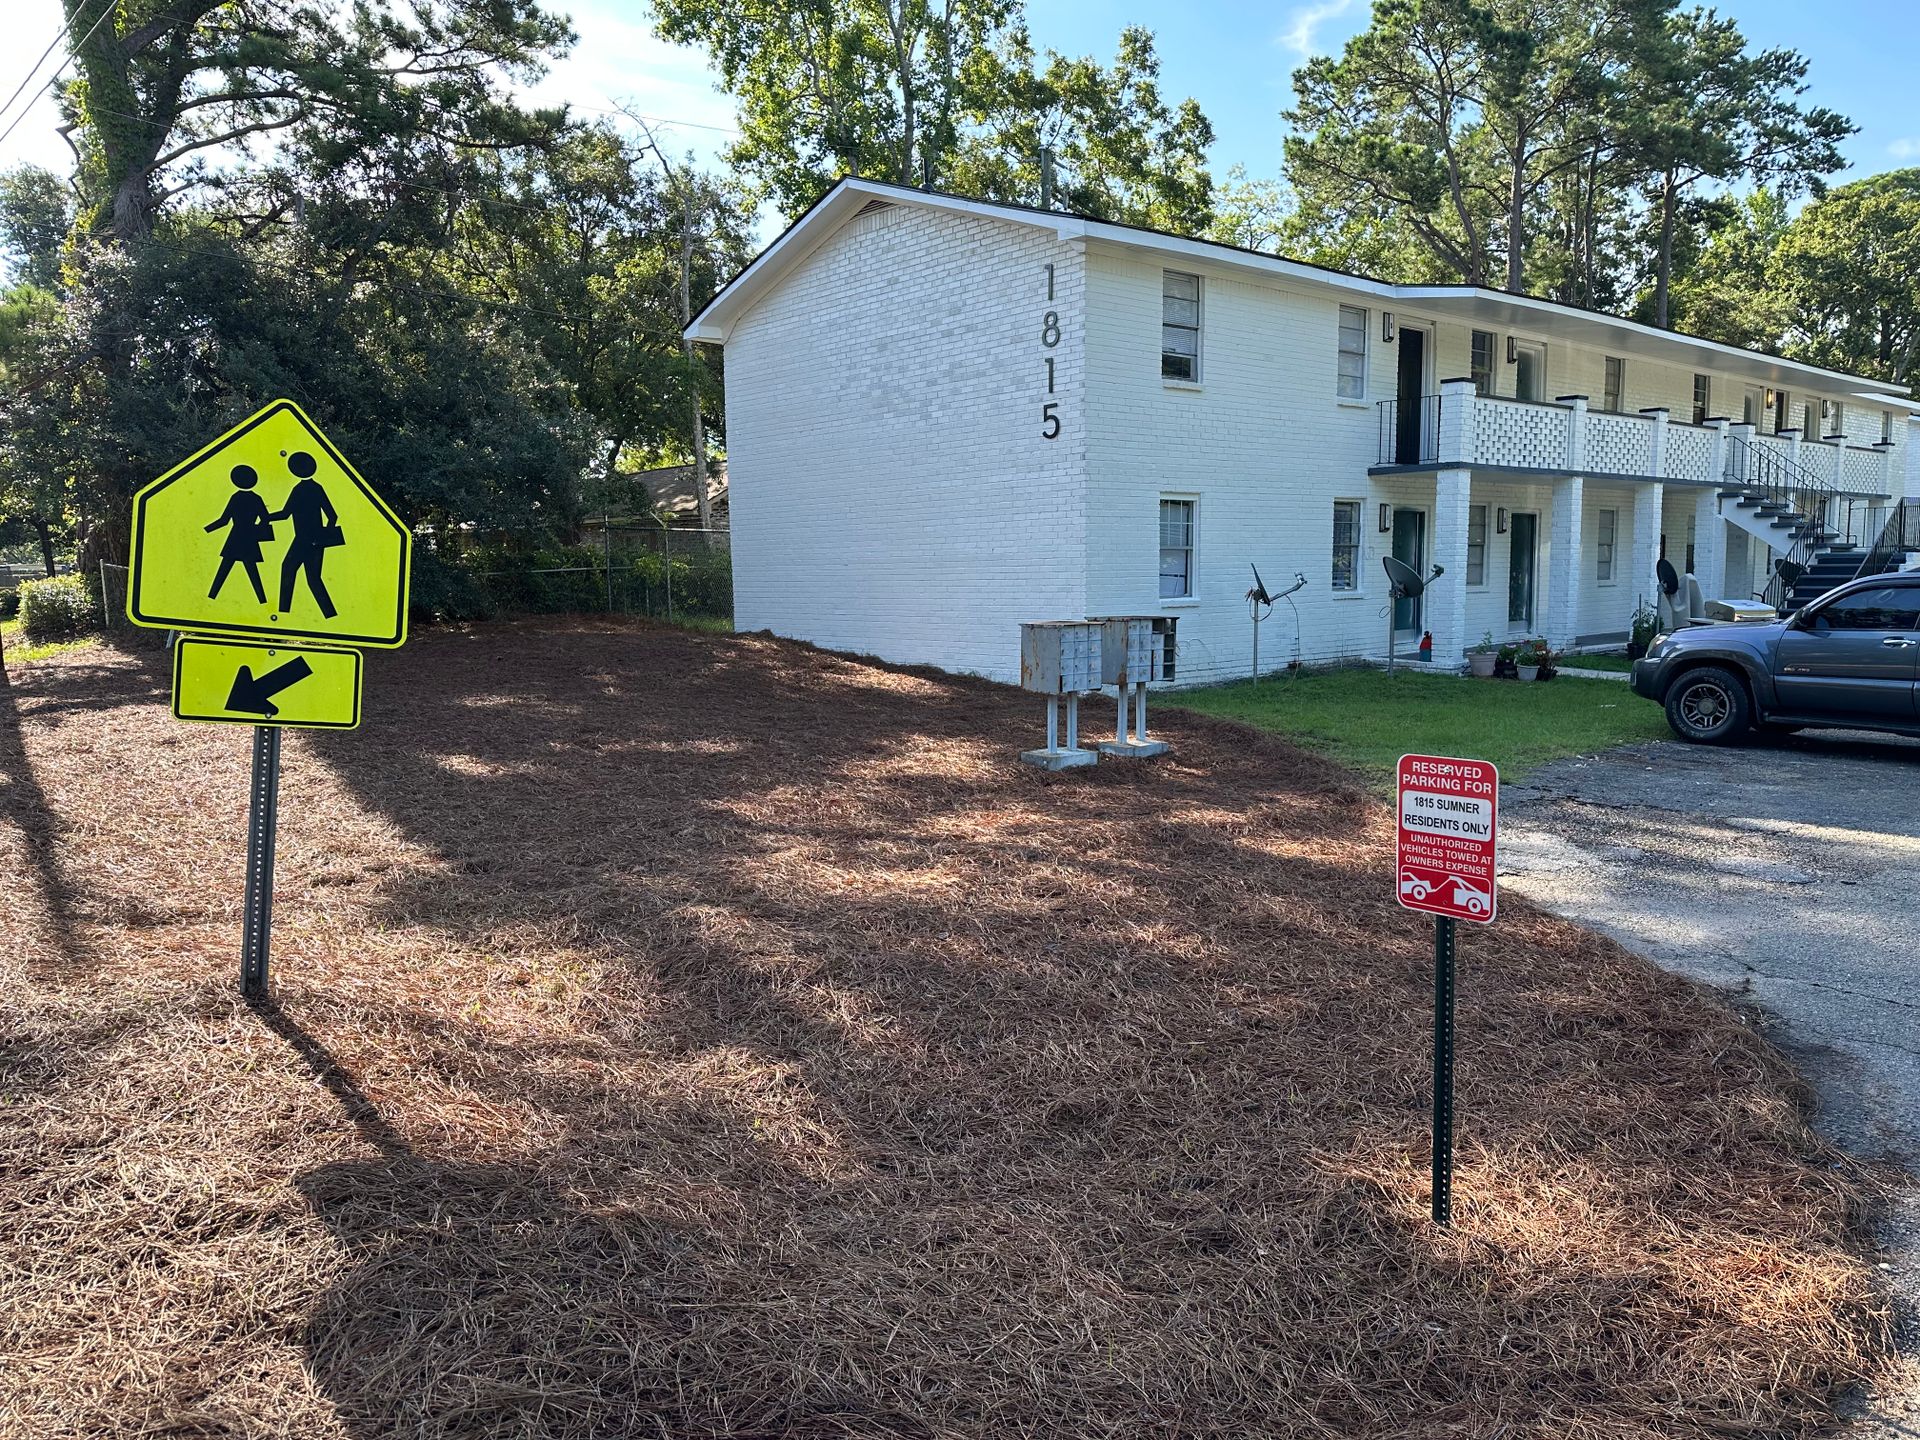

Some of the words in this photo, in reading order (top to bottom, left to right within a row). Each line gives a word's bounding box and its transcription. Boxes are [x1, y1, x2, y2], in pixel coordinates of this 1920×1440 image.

[1412, 761, 1482, 779] RESERVED
[1402, 774, 1461, 791] PARKING
[1464, 781, 1492, 794] FOR
[1414, 796, 1434, 808] 1815
[1437, 799, 1480, 814] SUMNER
[1404, 813, 1459, 831] RESIDENTS
[1462, 821, 1489, 835] ONLY
[1410, 834, 1482, 852] UNAUTHORIZED
[1400, 843, 1444, 858] VEHICLES
[1445, 850, 1479, 863] TOWED
[1480, 856, 1492, 865] AT
[1405, 855, 1444, 869] OWNERS
[1446, 861, 1487, 875] EXPENSE
